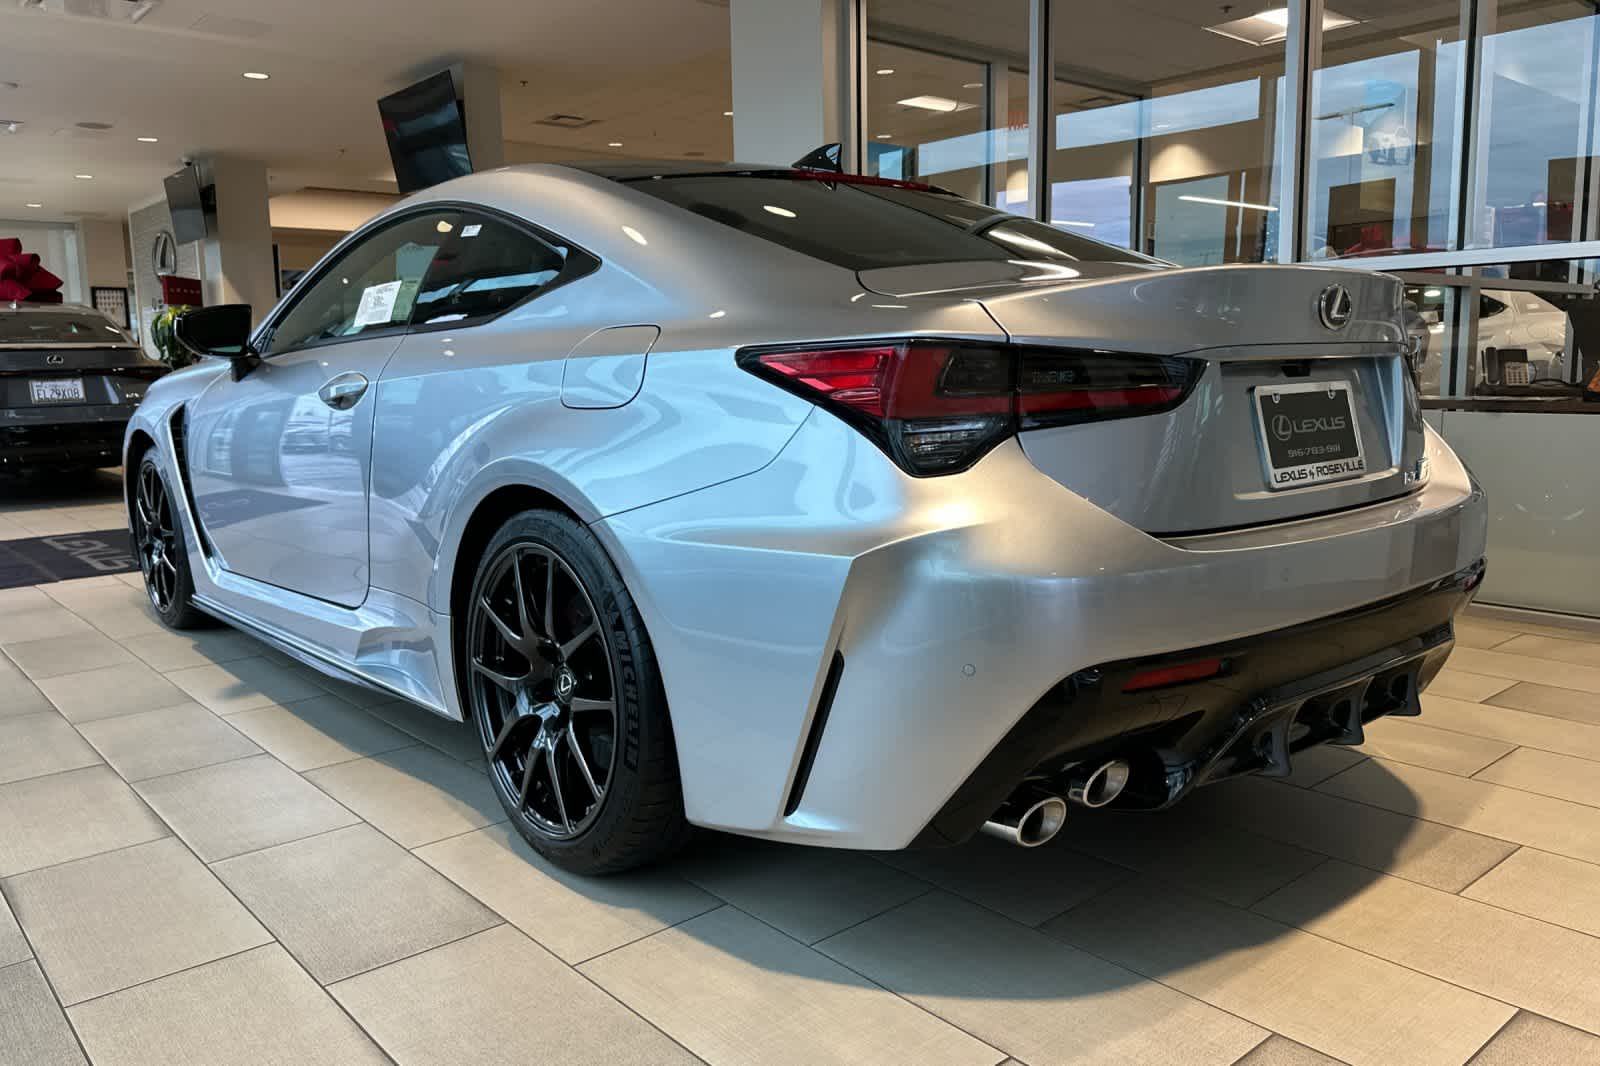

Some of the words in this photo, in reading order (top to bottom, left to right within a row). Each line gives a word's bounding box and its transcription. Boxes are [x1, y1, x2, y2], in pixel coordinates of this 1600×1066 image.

[1293, 416, 1345, 433] LEXUS
[1274, 468, 1308, 483] LEXUS
[1316, 460, 1363, 477] ROSEVILLE
